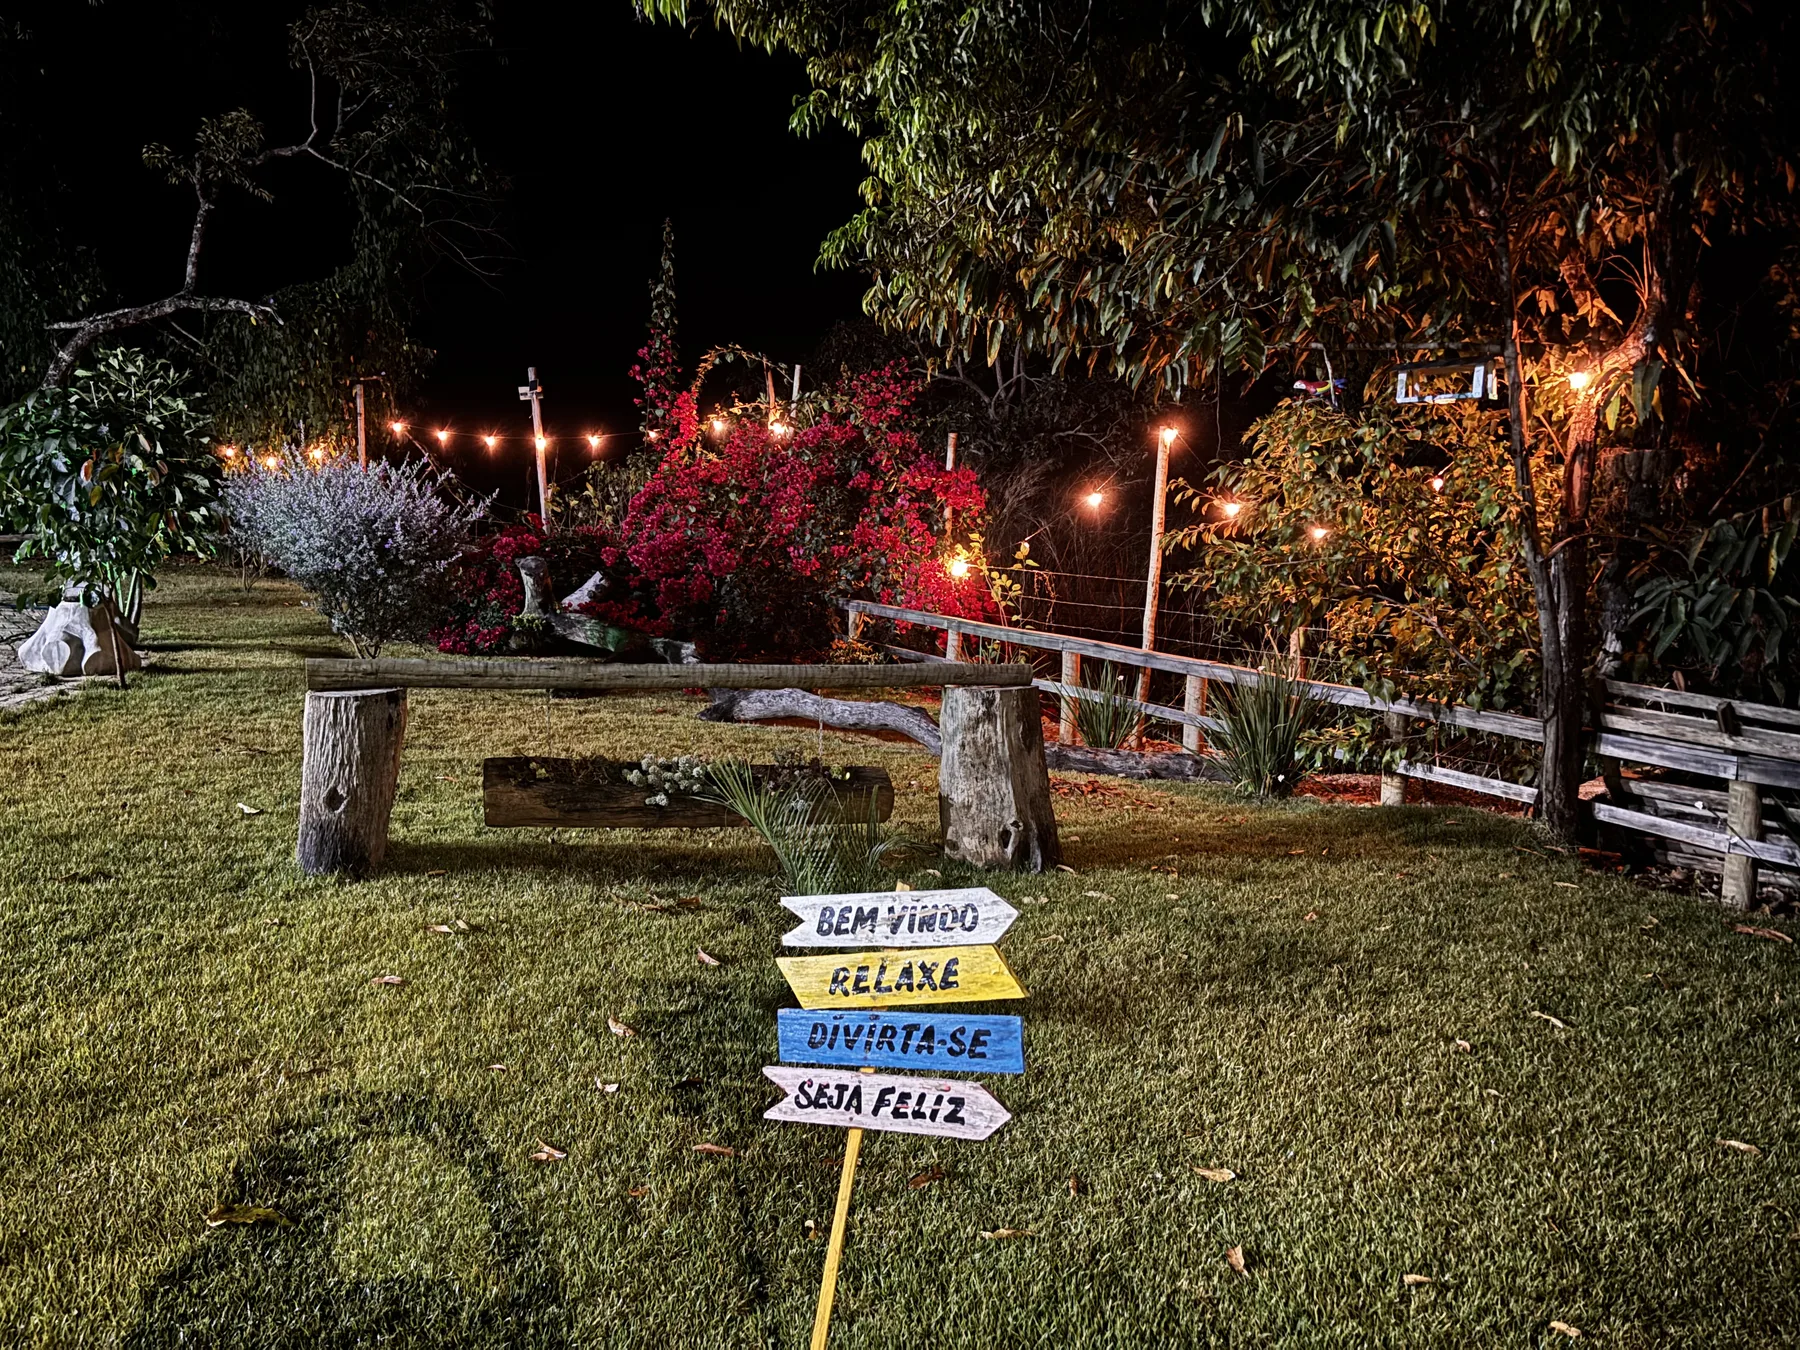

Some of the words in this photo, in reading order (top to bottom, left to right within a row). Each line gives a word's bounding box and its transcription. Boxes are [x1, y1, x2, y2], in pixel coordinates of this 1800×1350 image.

[816, 905, 879, 936] BEM
[887, 899, 979, 935] VINDO
[828, 957, 960, 997] RELAXE
[807, 1015, 992, 1059] DIVIRTA-SE
[794, 1078, 863, 1116] SEJA
[871, 1086, 966, 1126] FELIZ
